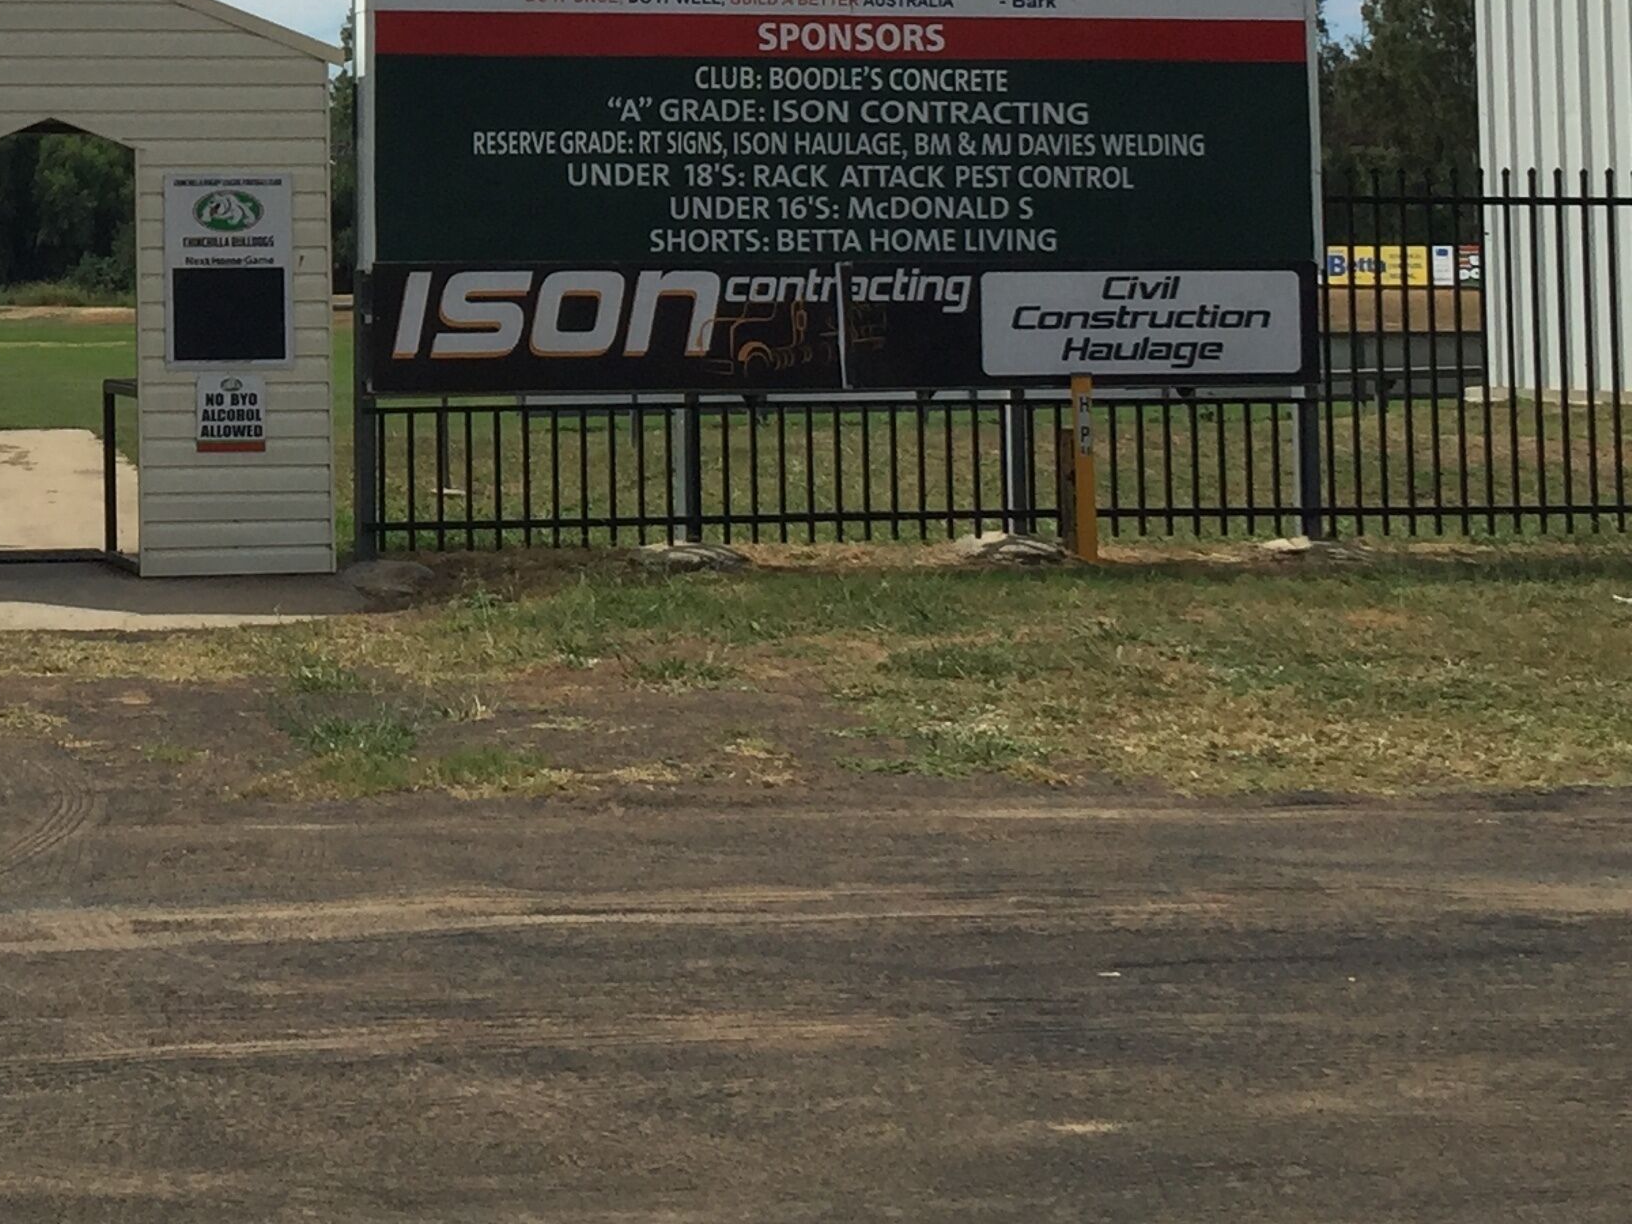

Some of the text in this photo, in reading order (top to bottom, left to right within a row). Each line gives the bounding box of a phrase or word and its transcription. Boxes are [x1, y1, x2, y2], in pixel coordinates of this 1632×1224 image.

[757, 22, 946, 52] SPONSORS
[694, 66, 762, 90] CLUB:
[889, 68, 1009, 93] CONCRETE
[659, 98, 766, 123] GRADE:
[772, 99, 850, 124] ISON
[860, 100, 1090, 126] CONTRACTING
[473, 131, 1206, 160] RESERVE GRADE: RT SIGNS, ISON HAULAGE, BM & MJ DAVIES WELDING
[567, 163, 671, 187] UNDER
[753, 164, 829, 188] RACK
[839, 164, 946, 188] ATTACK
[955, 164, 1012, 189] PEST
[1018, 165, 1135, 190] CONTROL
[670, 196, 770, 220] UNDER
[847, 196, 1010, 220] McDONALD
[1018, 196, 1034, 220] S
[649, 228, 1058, 253] SHORTS: BETTA HOME LIVING
[724, 267, 972, 314] contracting
[1101, 276, 1181, 301] Civil
[1011, 304, 1271, 331] Construction
[1060, 335, 1223, 366] Haulage
[205, 392, 258, 406] NO BYO
[201, 408, 262, 422] ALCOHOL
[200, 425, 263, 438] ALLOWED
